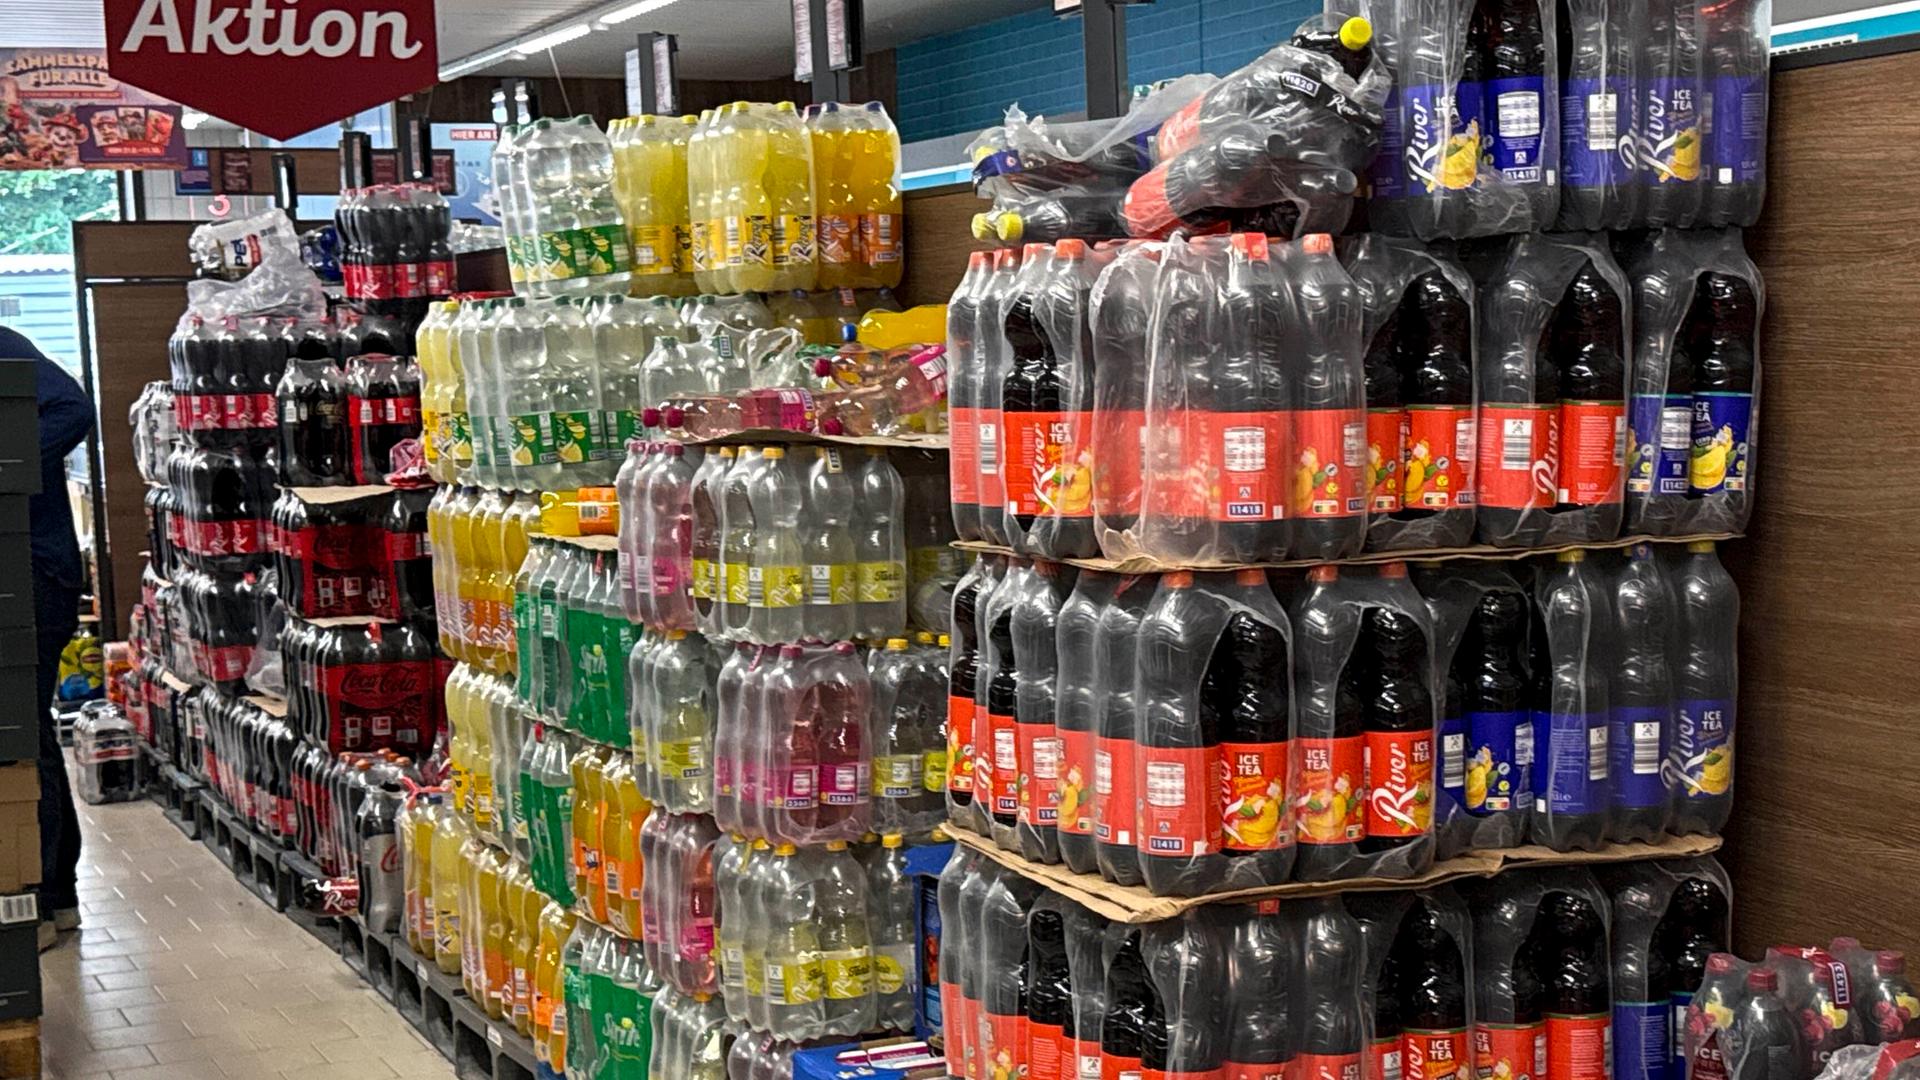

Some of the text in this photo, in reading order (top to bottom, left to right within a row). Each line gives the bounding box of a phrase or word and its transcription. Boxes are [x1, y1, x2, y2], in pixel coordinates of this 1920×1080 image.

[120, 0, 423, 59] Aktion
[1674, 90, 1691, 100] ICE
[1672, 100, 1693, 110] TEA
[1636, 89, 1681, 178] River
[1406, 97, 1442, 184] River
[1695, 402, 1710, 412] CE
[1695, 412, 1711, 422] EA
[1051, 423, 1070, 432] ICE
[1049, 433, 1073, 443] TEA
[1032, 422, 1058, 513] River
[1703, 711, 1721, 720] ICE
[1701, 721, 1723, 730] TEA
[1414, 741, 1429, 751] ICE
[1661, 709, 1706, 793] River
[1239, 754, 1260, 765] ICE
[1307, 749, 1327, 760] ICE
[1412, 751, 1430, 762] TEA
[1305, 759, 1330, 770] TEA
[1237, 765, 1262, 776] TEA
[1372, 742, 1419, 830] River
[1431, 1040, 1451, 1050] ICE
[1429, 1050, 1454, 1060] TEA
[1694, 1045, 1721, 1060] ICE
